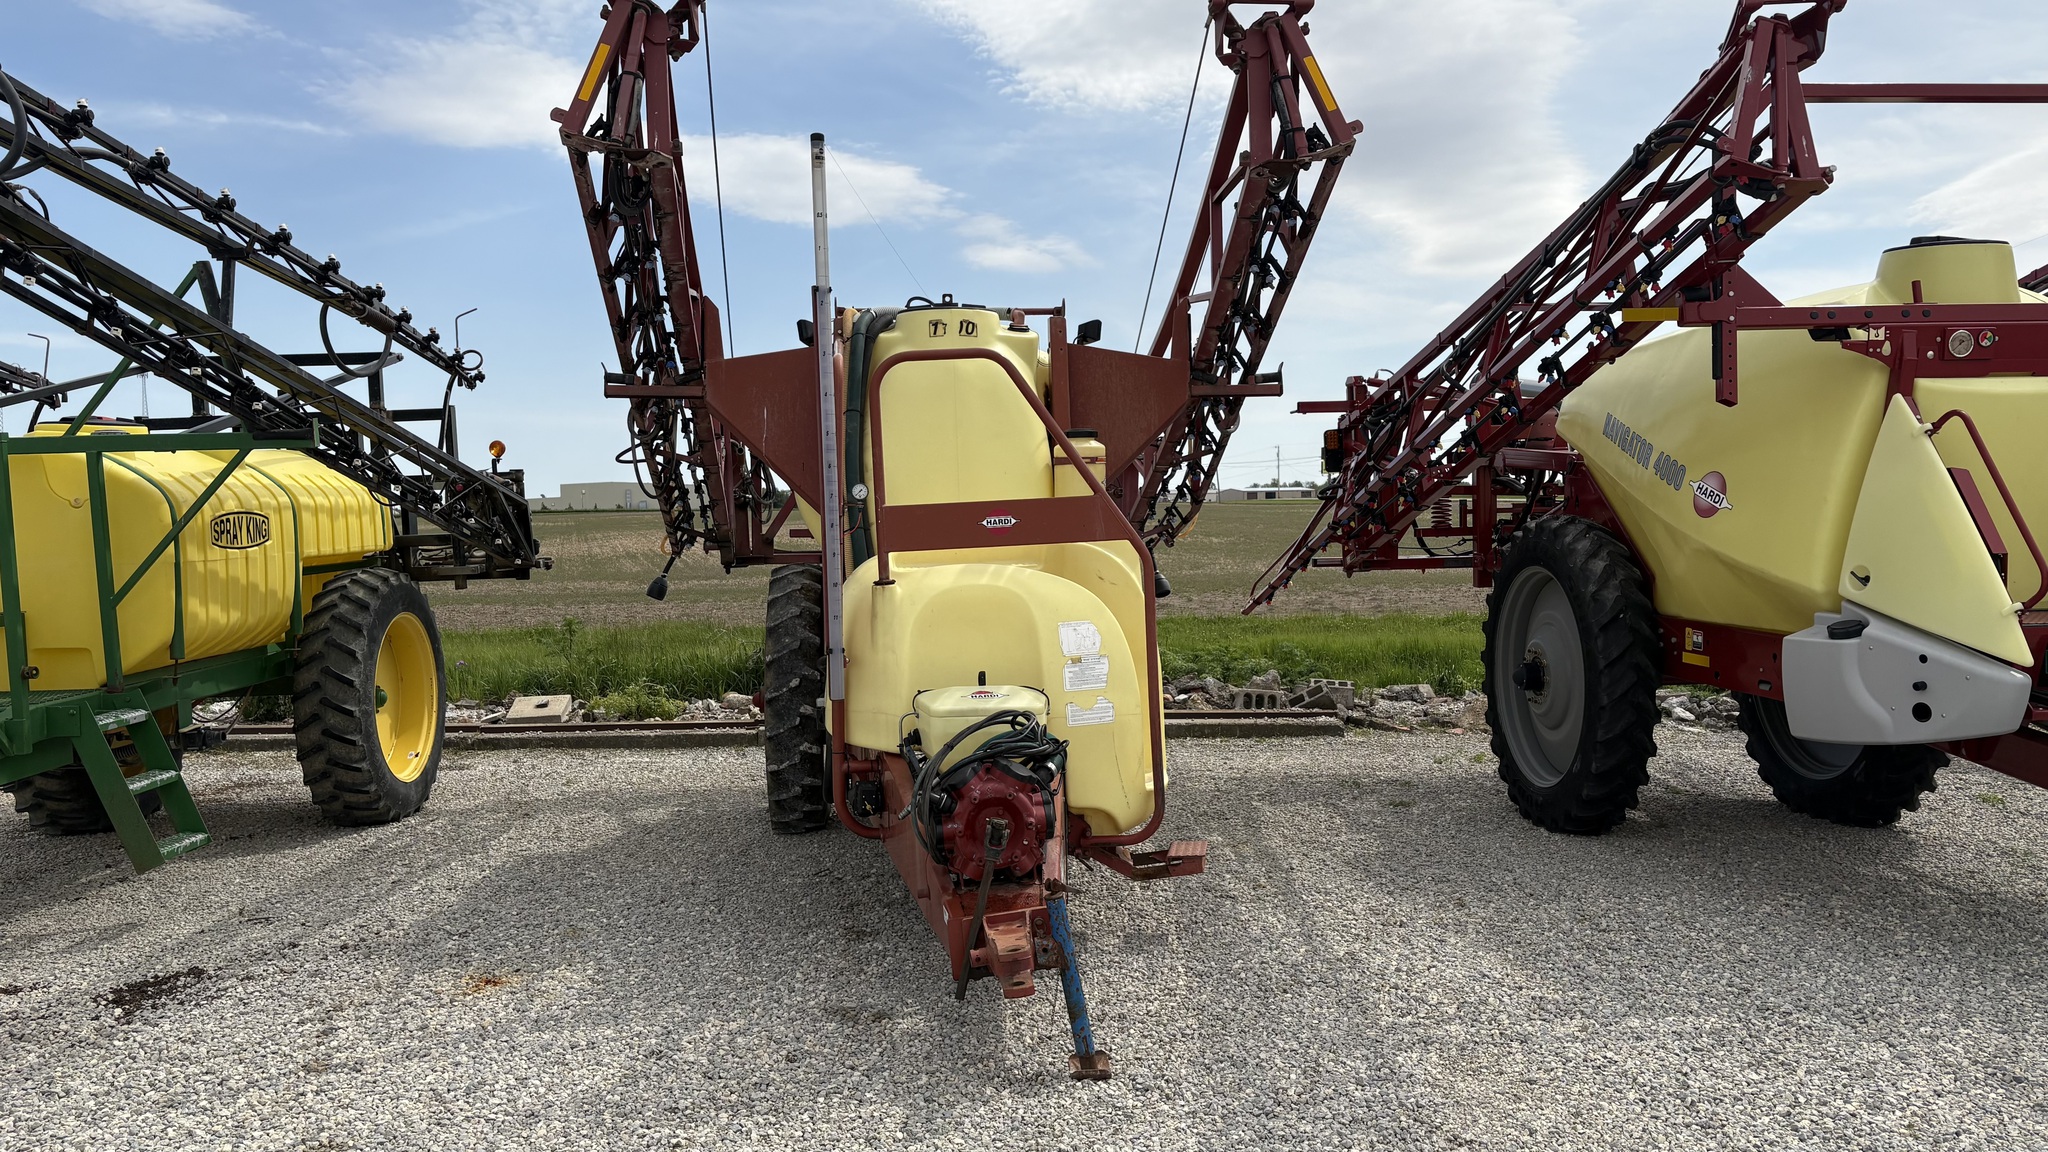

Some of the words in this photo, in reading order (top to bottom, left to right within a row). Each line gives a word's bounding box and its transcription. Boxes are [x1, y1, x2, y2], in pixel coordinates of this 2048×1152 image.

[1602, 412, 1654, 470] NAVIGATOR
[1653, 451, 1687, 491] 4000
[1695, 482, 1725, 507] HARDI
[213, 516, 243, 545] SPRAY
[246, 516, 267, 544] KING
[986, 518, 1012, 526] HARDI
